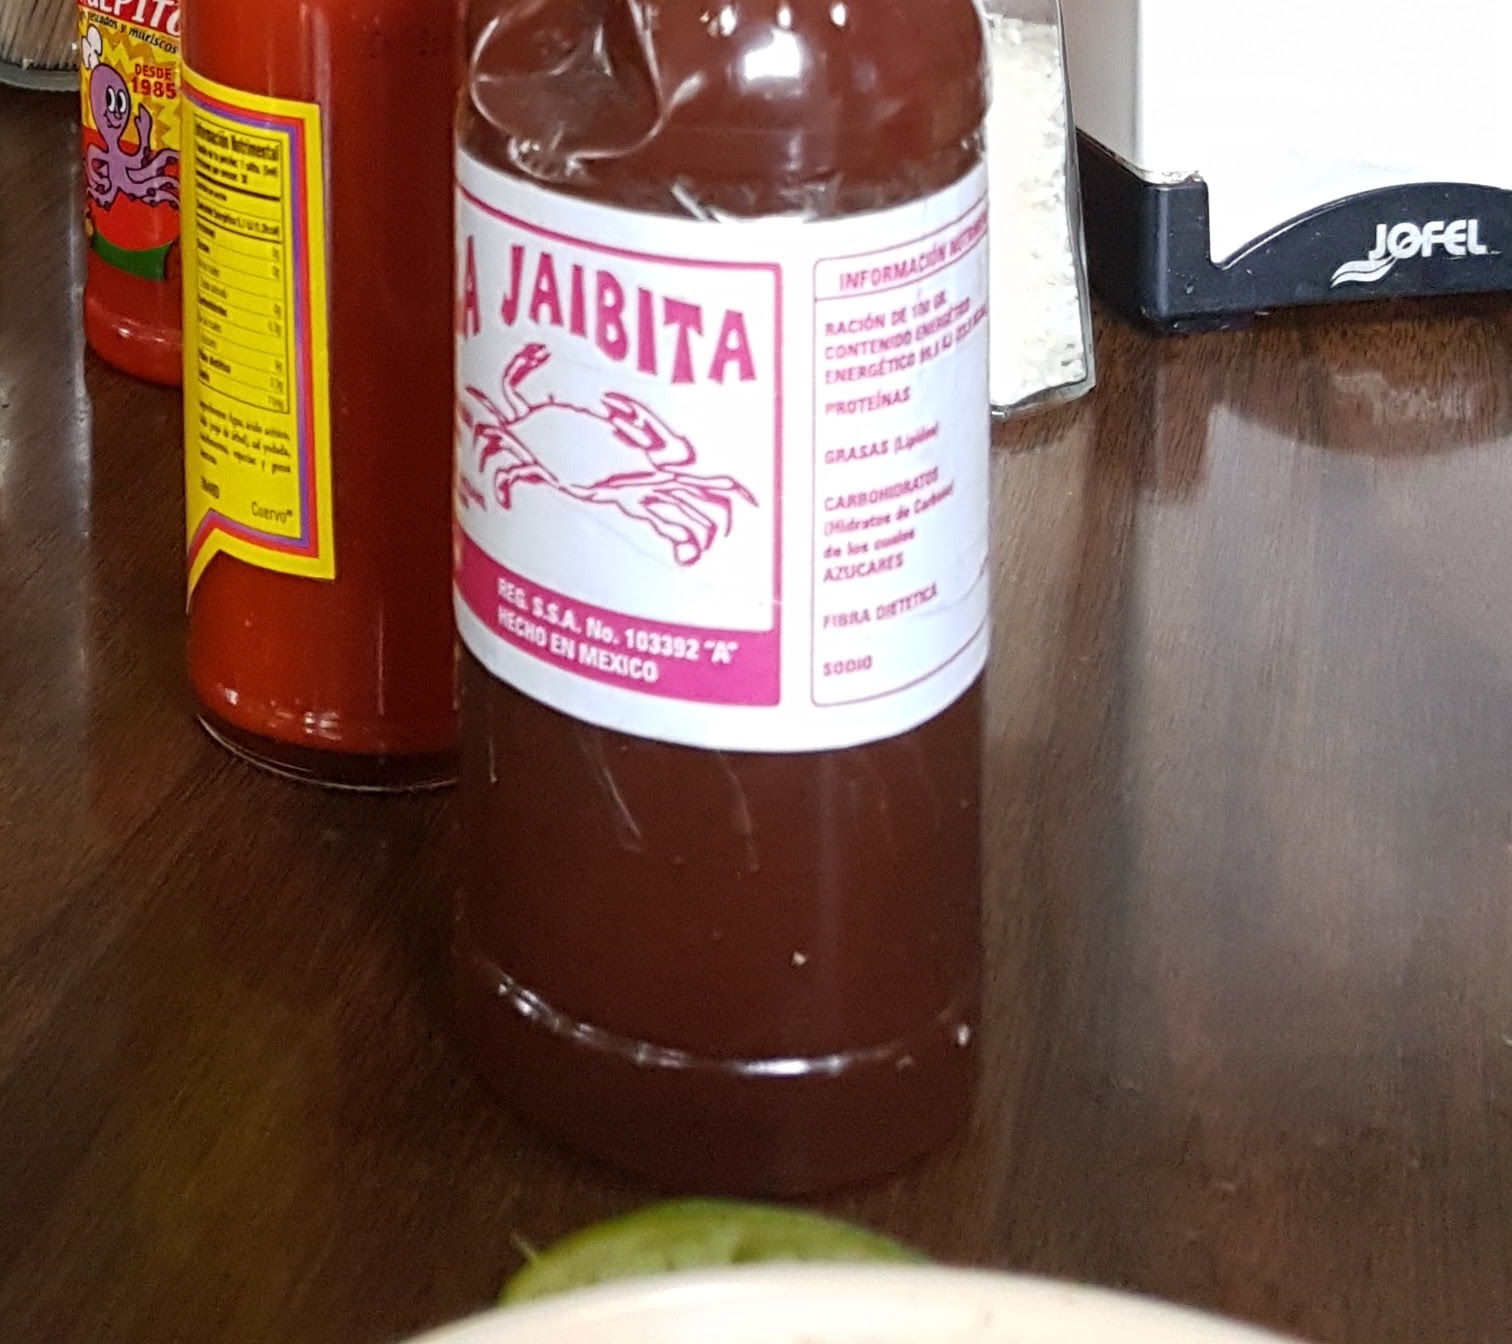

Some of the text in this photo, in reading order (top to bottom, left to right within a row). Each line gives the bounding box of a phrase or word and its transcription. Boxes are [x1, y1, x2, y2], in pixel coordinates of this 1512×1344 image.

[129, 26, 179, 54] mariscos
[134, 63, 172, 82] DESDE
[131, 76, 178, 100] 1985
[1368, 219, 1488, 261] JOFEL
[839, 241, 947, 292] INFORMACIÓN
[454, 234, 757, 385] A JAIBITA
[825, 312, 886, 336] RACIÓN
[891, 307, 907, 325] DE
[825, 330, 912, 360] CONTENIDO
[825, 352, 915, 384] ENERGÉTICO
[825, 387, 910, 416] PROTEÍNAS
[824, 440, 888, 464] GRASAS
[824, 466, 939, 511] CARBOHIDRATOS
[896, 503, 910, 521] de
[824, 528, 915, 559] de los cuales
[823, 552, 904, 582] AZUCARES
[497, 577, 529, 612] REG.
[531, 596, 582, 635] S.S.A.
[586, 616, 618, 645] No.
[624, 627, 700, 661] 103392
[823, 608, 870, 629] FIBRA
[497, 605, 659, 684] HECHO EN MEXICO
[823, 655, 873, 676] SODIO
